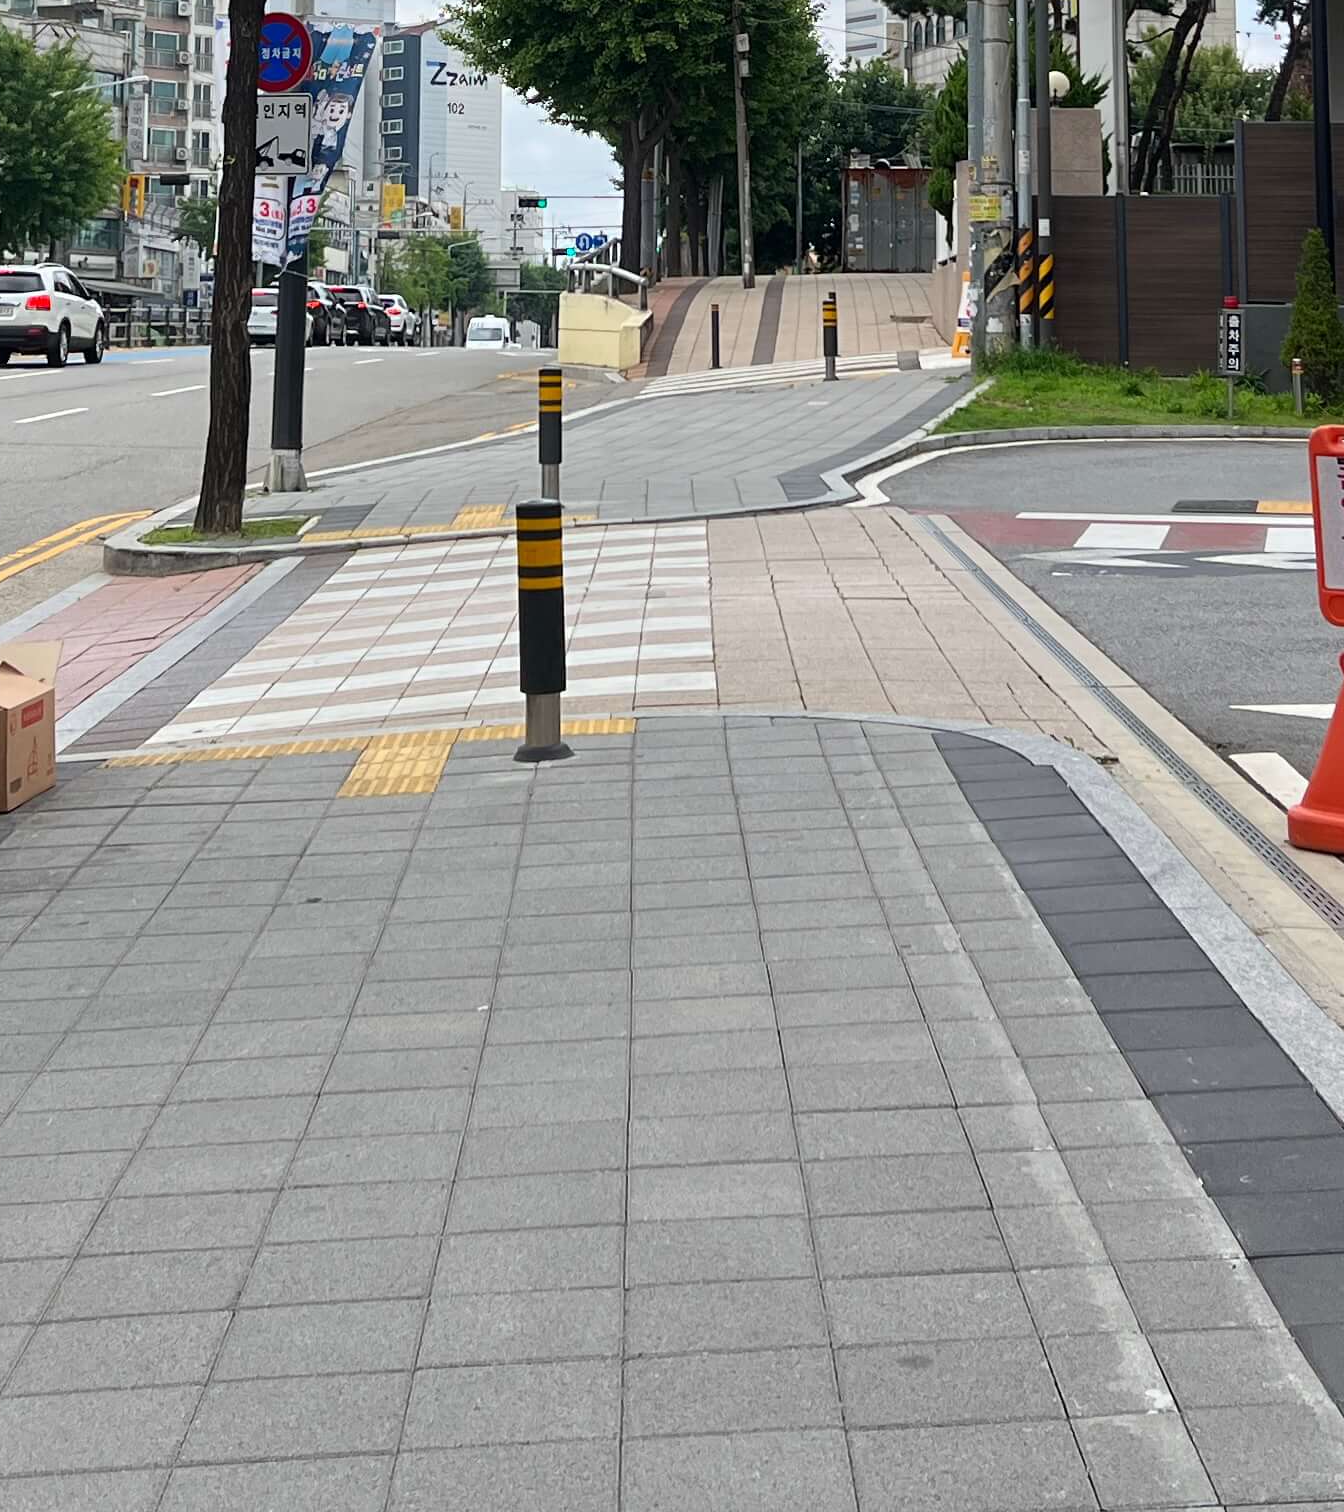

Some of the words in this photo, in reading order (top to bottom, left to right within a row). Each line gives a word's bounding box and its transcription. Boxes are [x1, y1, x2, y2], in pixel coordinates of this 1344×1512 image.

[260, 47, 302, 60] 정차금지
[256, 103, 306, 119] 인지역
[447, 102, 465, 115] 102
